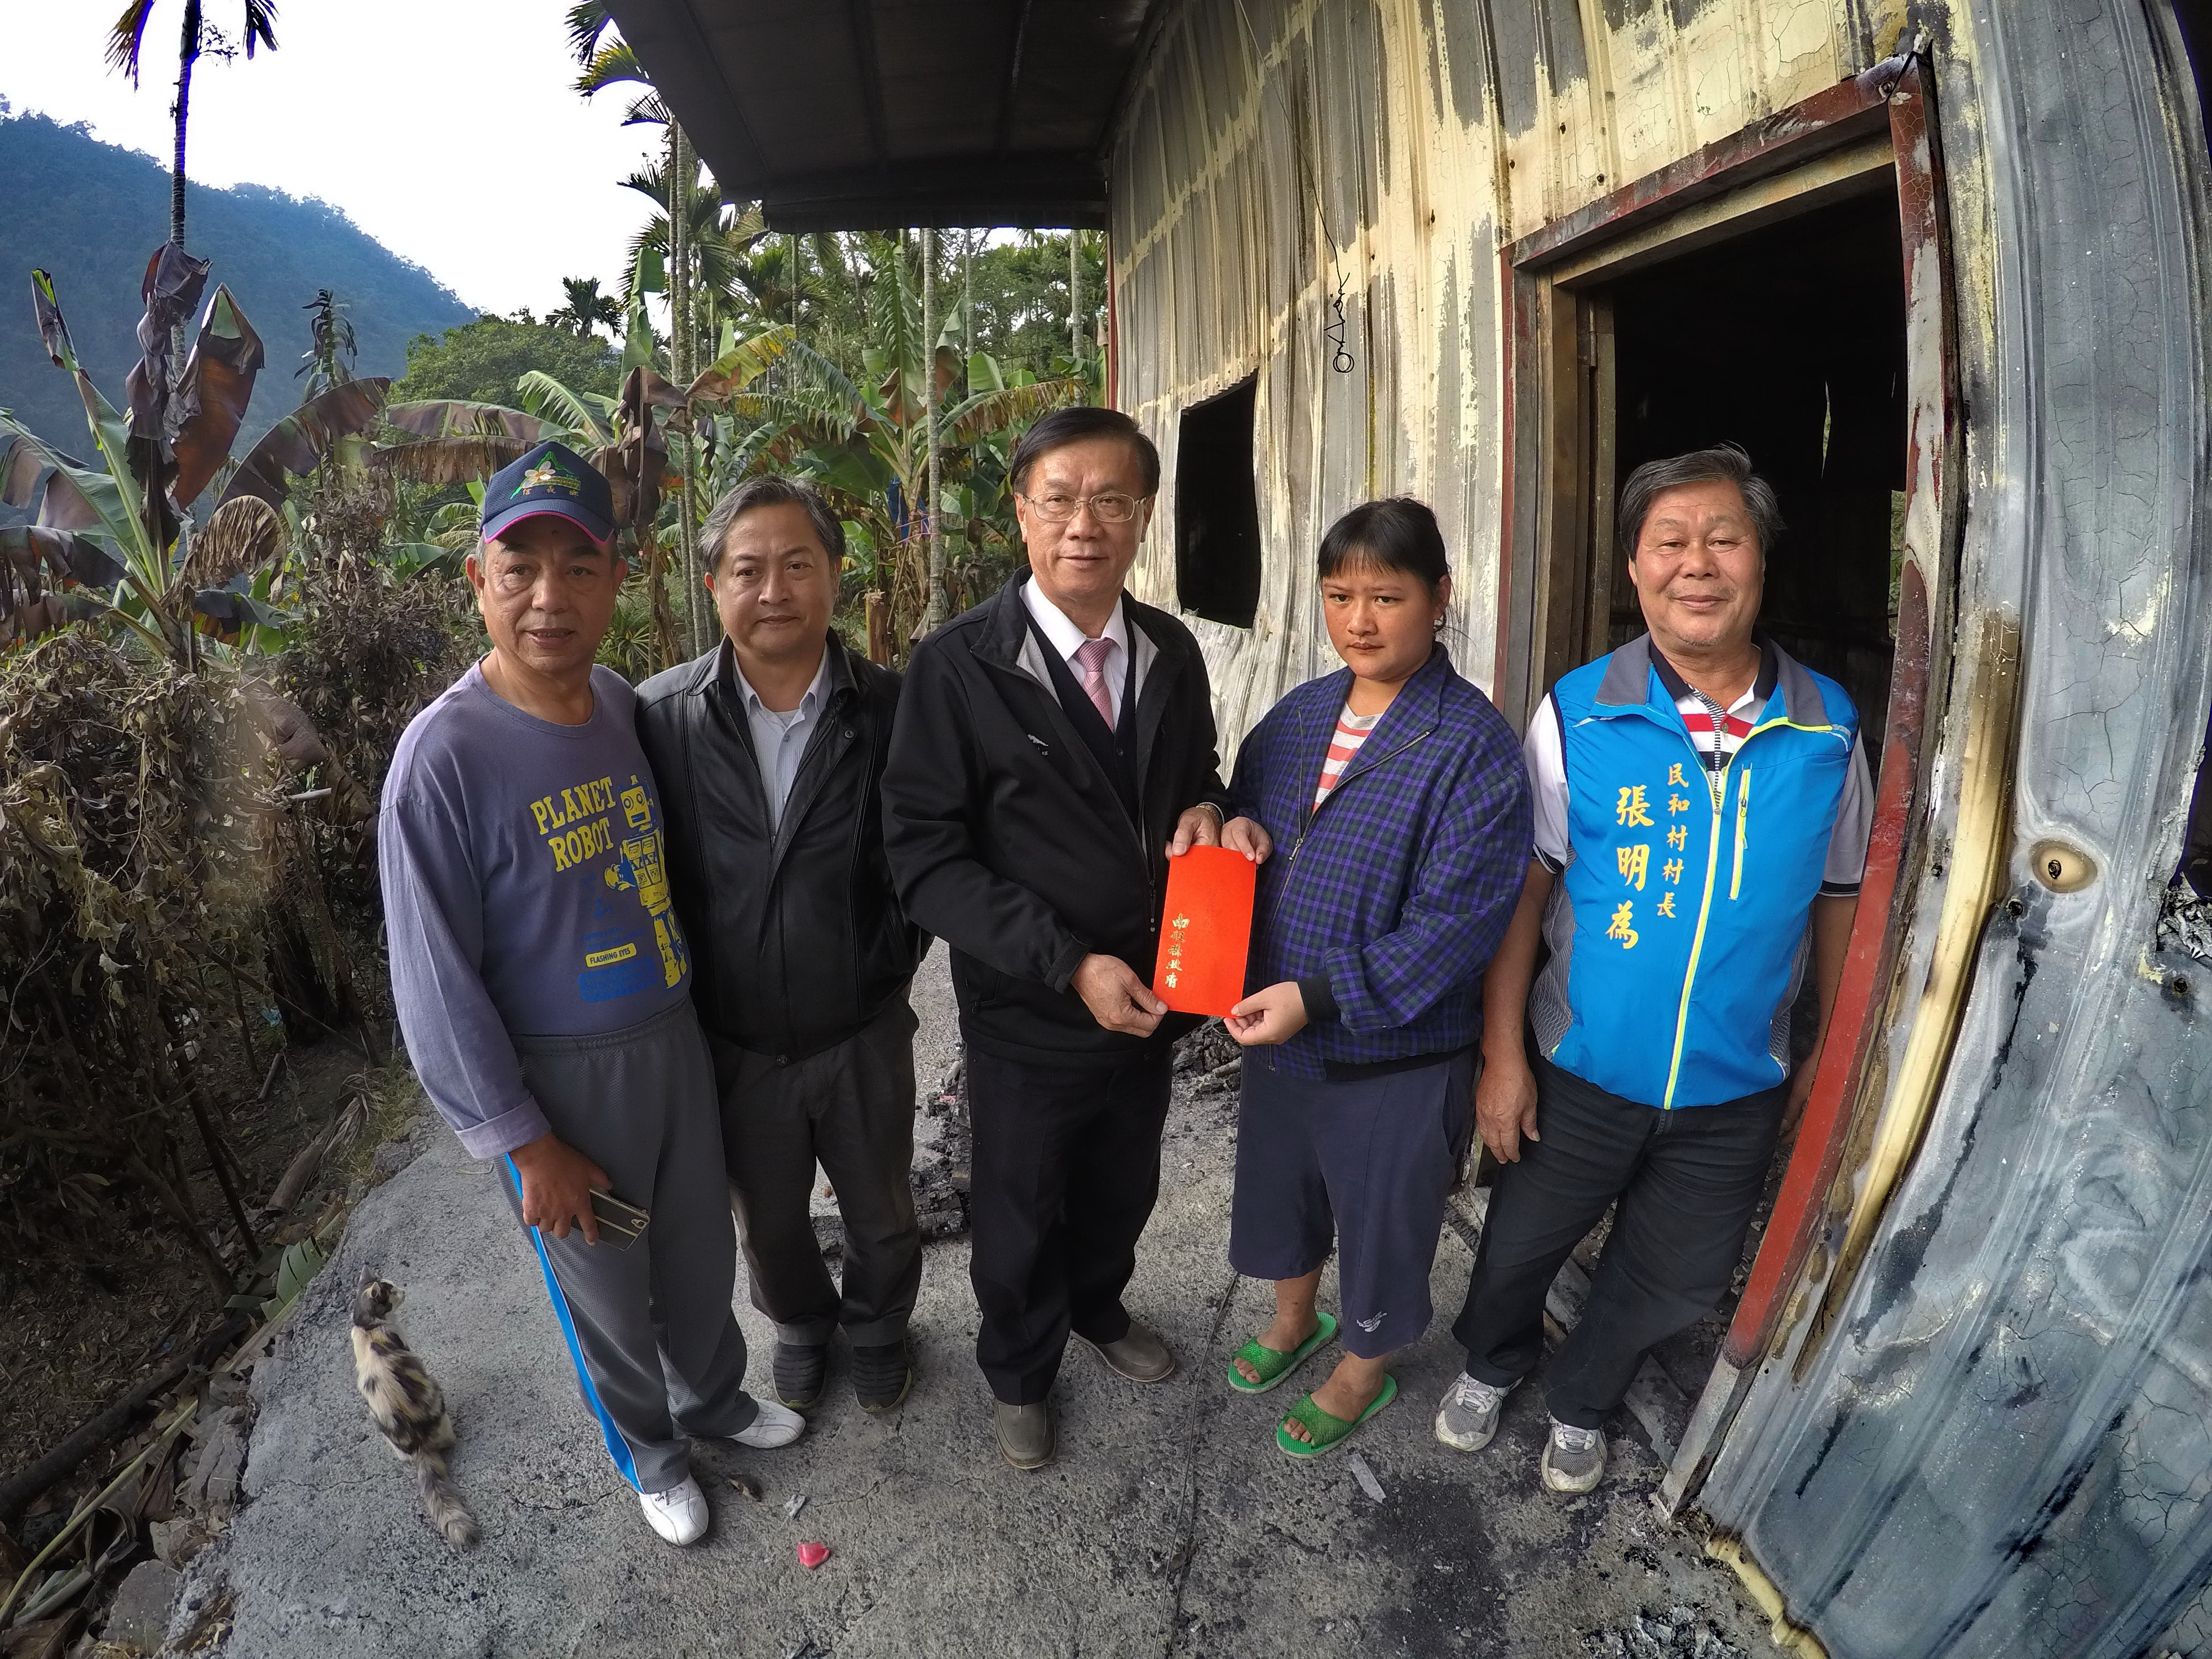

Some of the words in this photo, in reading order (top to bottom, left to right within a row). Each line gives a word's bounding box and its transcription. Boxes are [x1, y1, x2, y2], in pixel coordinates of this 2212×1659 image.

[530, 775, 616, 835] PLANET
[548, 817, 614, 872] ROBOT
[1605, 784, 1655, 950] 張明為
[1657, 763, 1690, 918] 民和村村長
[589, 951, 618, 964] FLASHING
[619, 947, 631, 957] EYES
